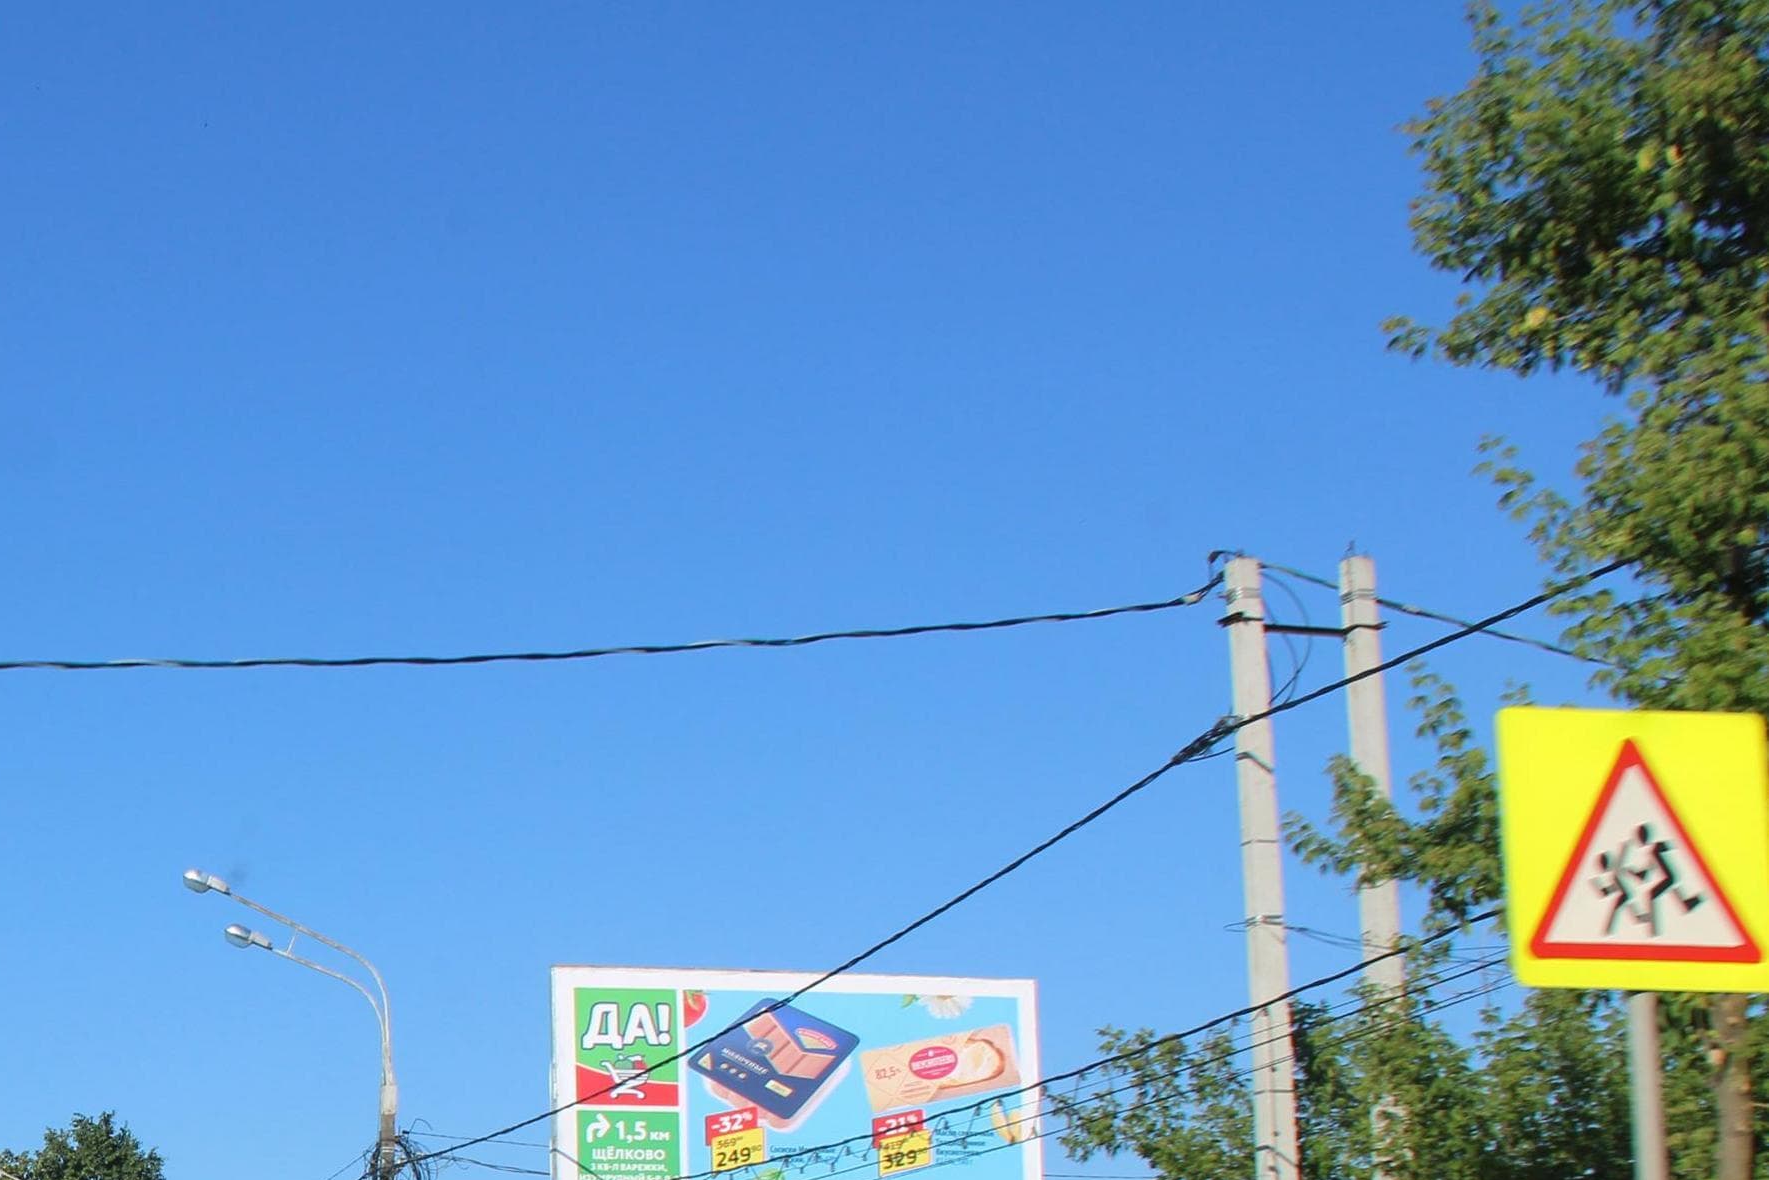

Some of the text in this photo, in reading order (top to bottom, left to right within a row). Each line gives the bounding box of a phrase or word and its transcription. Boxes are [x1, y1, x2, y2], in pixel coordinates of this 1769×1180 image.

[581, 1002, 672, 1050] ДА!
[615, 1121, 670, 1144] 1,5 км
[711, 1112, 754, 1133] -32%
[592, 1146, 666, 1161] ЩЁЛКОВО
[716, 1147, 751, 1168] 249
[883, 1150, 917, 1170] 329
